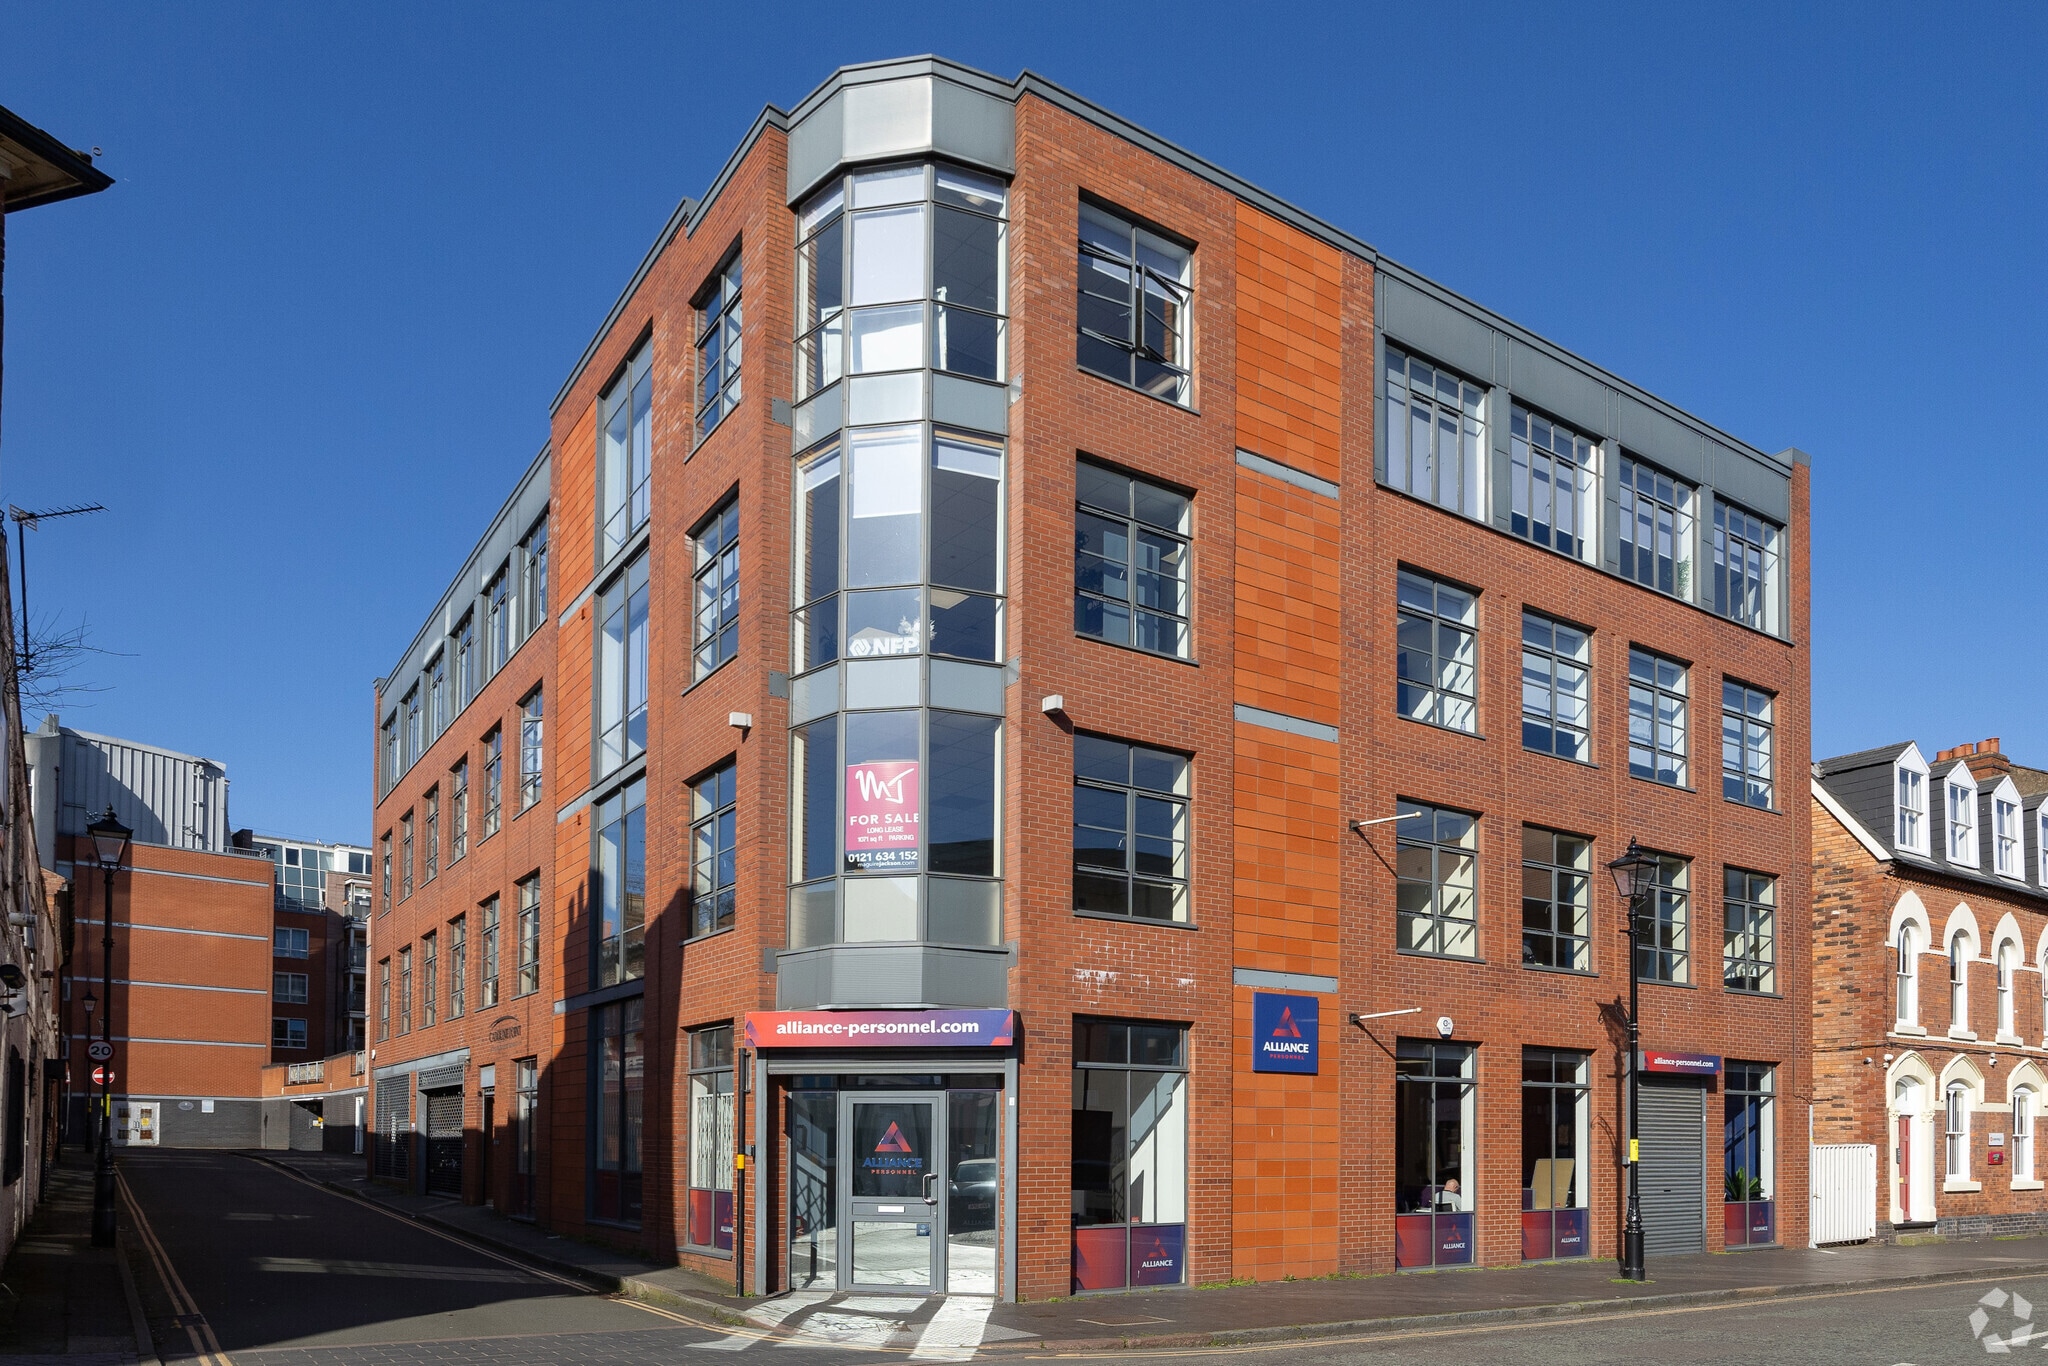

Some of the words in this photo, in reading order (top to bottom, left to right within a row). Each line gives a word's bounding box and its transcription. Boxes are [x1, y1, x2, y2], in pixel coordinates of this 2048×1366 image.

[873, 636, 918, 655] NFP
[850, 814, 879, 826] FOR
[885, 813, 919, 824] SALE
[848, 852, 872, 863] 0121
[875, 851, 896, 861] 634
[857, 860, 915, 868] maguirejackson.com
[776, 1019, 979, 1037] alliance-personnel.com
[90, 1045, 111, 1056] 20
[1263, 1041, 1310, 1054] ALLIANCE
[1653, 1057, 1714, 1068] alliance-personnel.com
[862, 1157, 923, 1168] ALLIANCE
[1443, 1242, 1466, 1250] ALLIANCE
[1141, 1259, 1174, 1268] ALLIANCE
